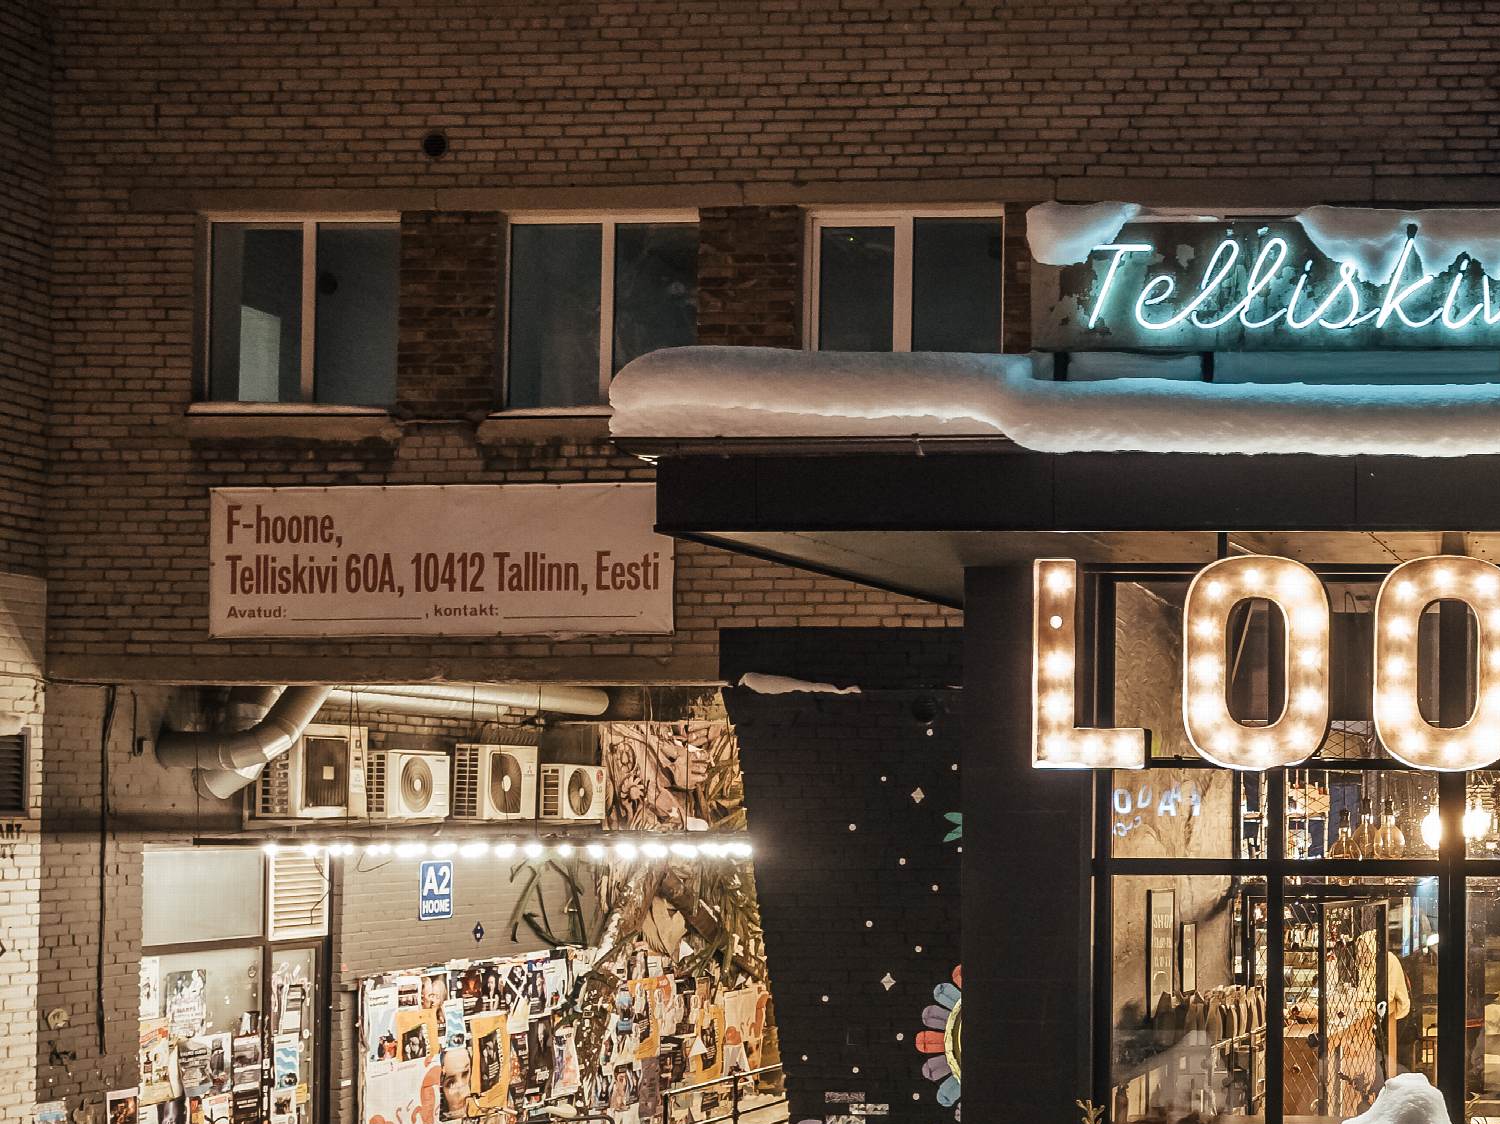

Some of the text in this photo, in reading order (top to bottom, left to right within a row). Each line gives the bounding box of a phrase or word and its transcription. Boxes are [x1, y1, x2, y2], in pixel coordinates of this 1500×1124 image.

[226, 504, 343, 548] F-hoone,
[225, 550, 660, 598] Telliskivi 60A, 10412 Tallinn, Eesti
[226, 604, 499, 619] Avatud: kontakt:
[422, 865, 450, 896] A2
[422, 899, 450, 914] HOONE
